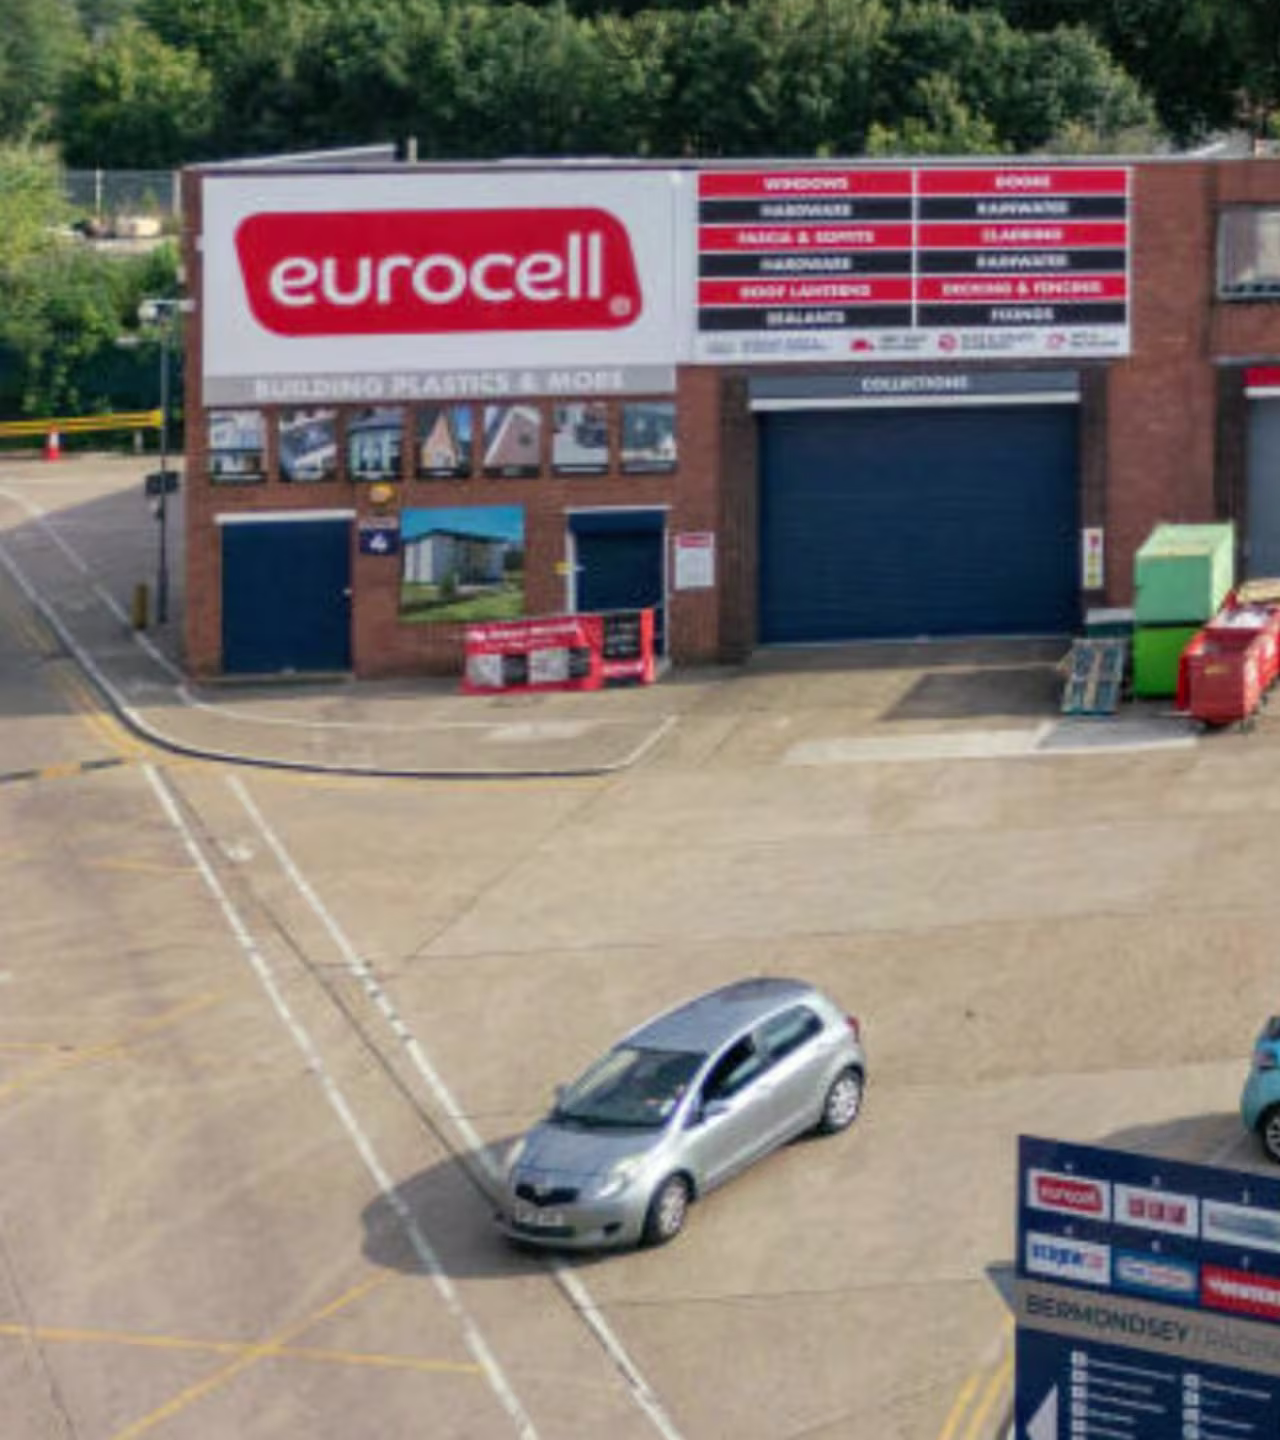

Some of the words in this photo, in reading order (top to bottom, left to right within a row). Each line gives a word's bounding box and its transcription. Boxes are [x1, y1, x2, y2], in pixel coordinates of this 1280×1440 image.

[269, 231, 604, 307] eurocell
[255, 379, 383, 402] BUILDING
[390, 375, 510, 398] PLASTICS
[550, 370, 625, 392] MORE
[369, 533, 389, 551] 4
[1026, 1293, 1190, 1343] BERMONDSEY
